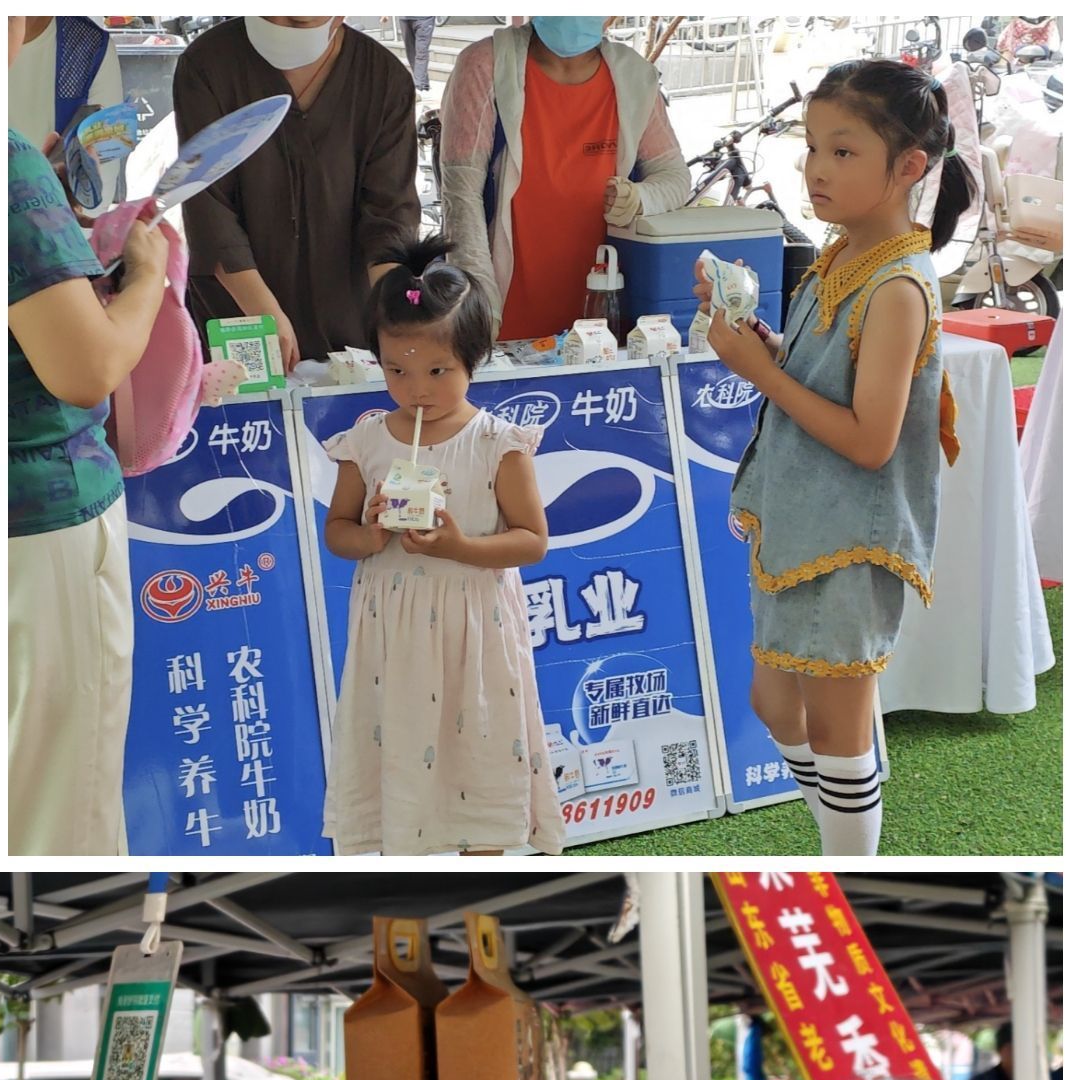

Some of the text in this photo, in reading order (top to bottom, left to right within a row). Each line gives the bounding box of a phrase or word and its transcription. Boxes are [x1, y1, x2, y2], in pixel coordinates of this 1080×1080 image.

[571, 386, 637, 427] 牛奶
[691, 381, 755, 408] 农科院
[208, 420, 271, 456] 牛奶
[205, 564, 260, 596] 兴牛
[584, 669, 667, 702] 专属牧场
[589, 694, 671, 728] 新鲜直达
[166, 652, 223, 848] 科学养牛
[226, 645, 281, 840] 农科院牛奶
